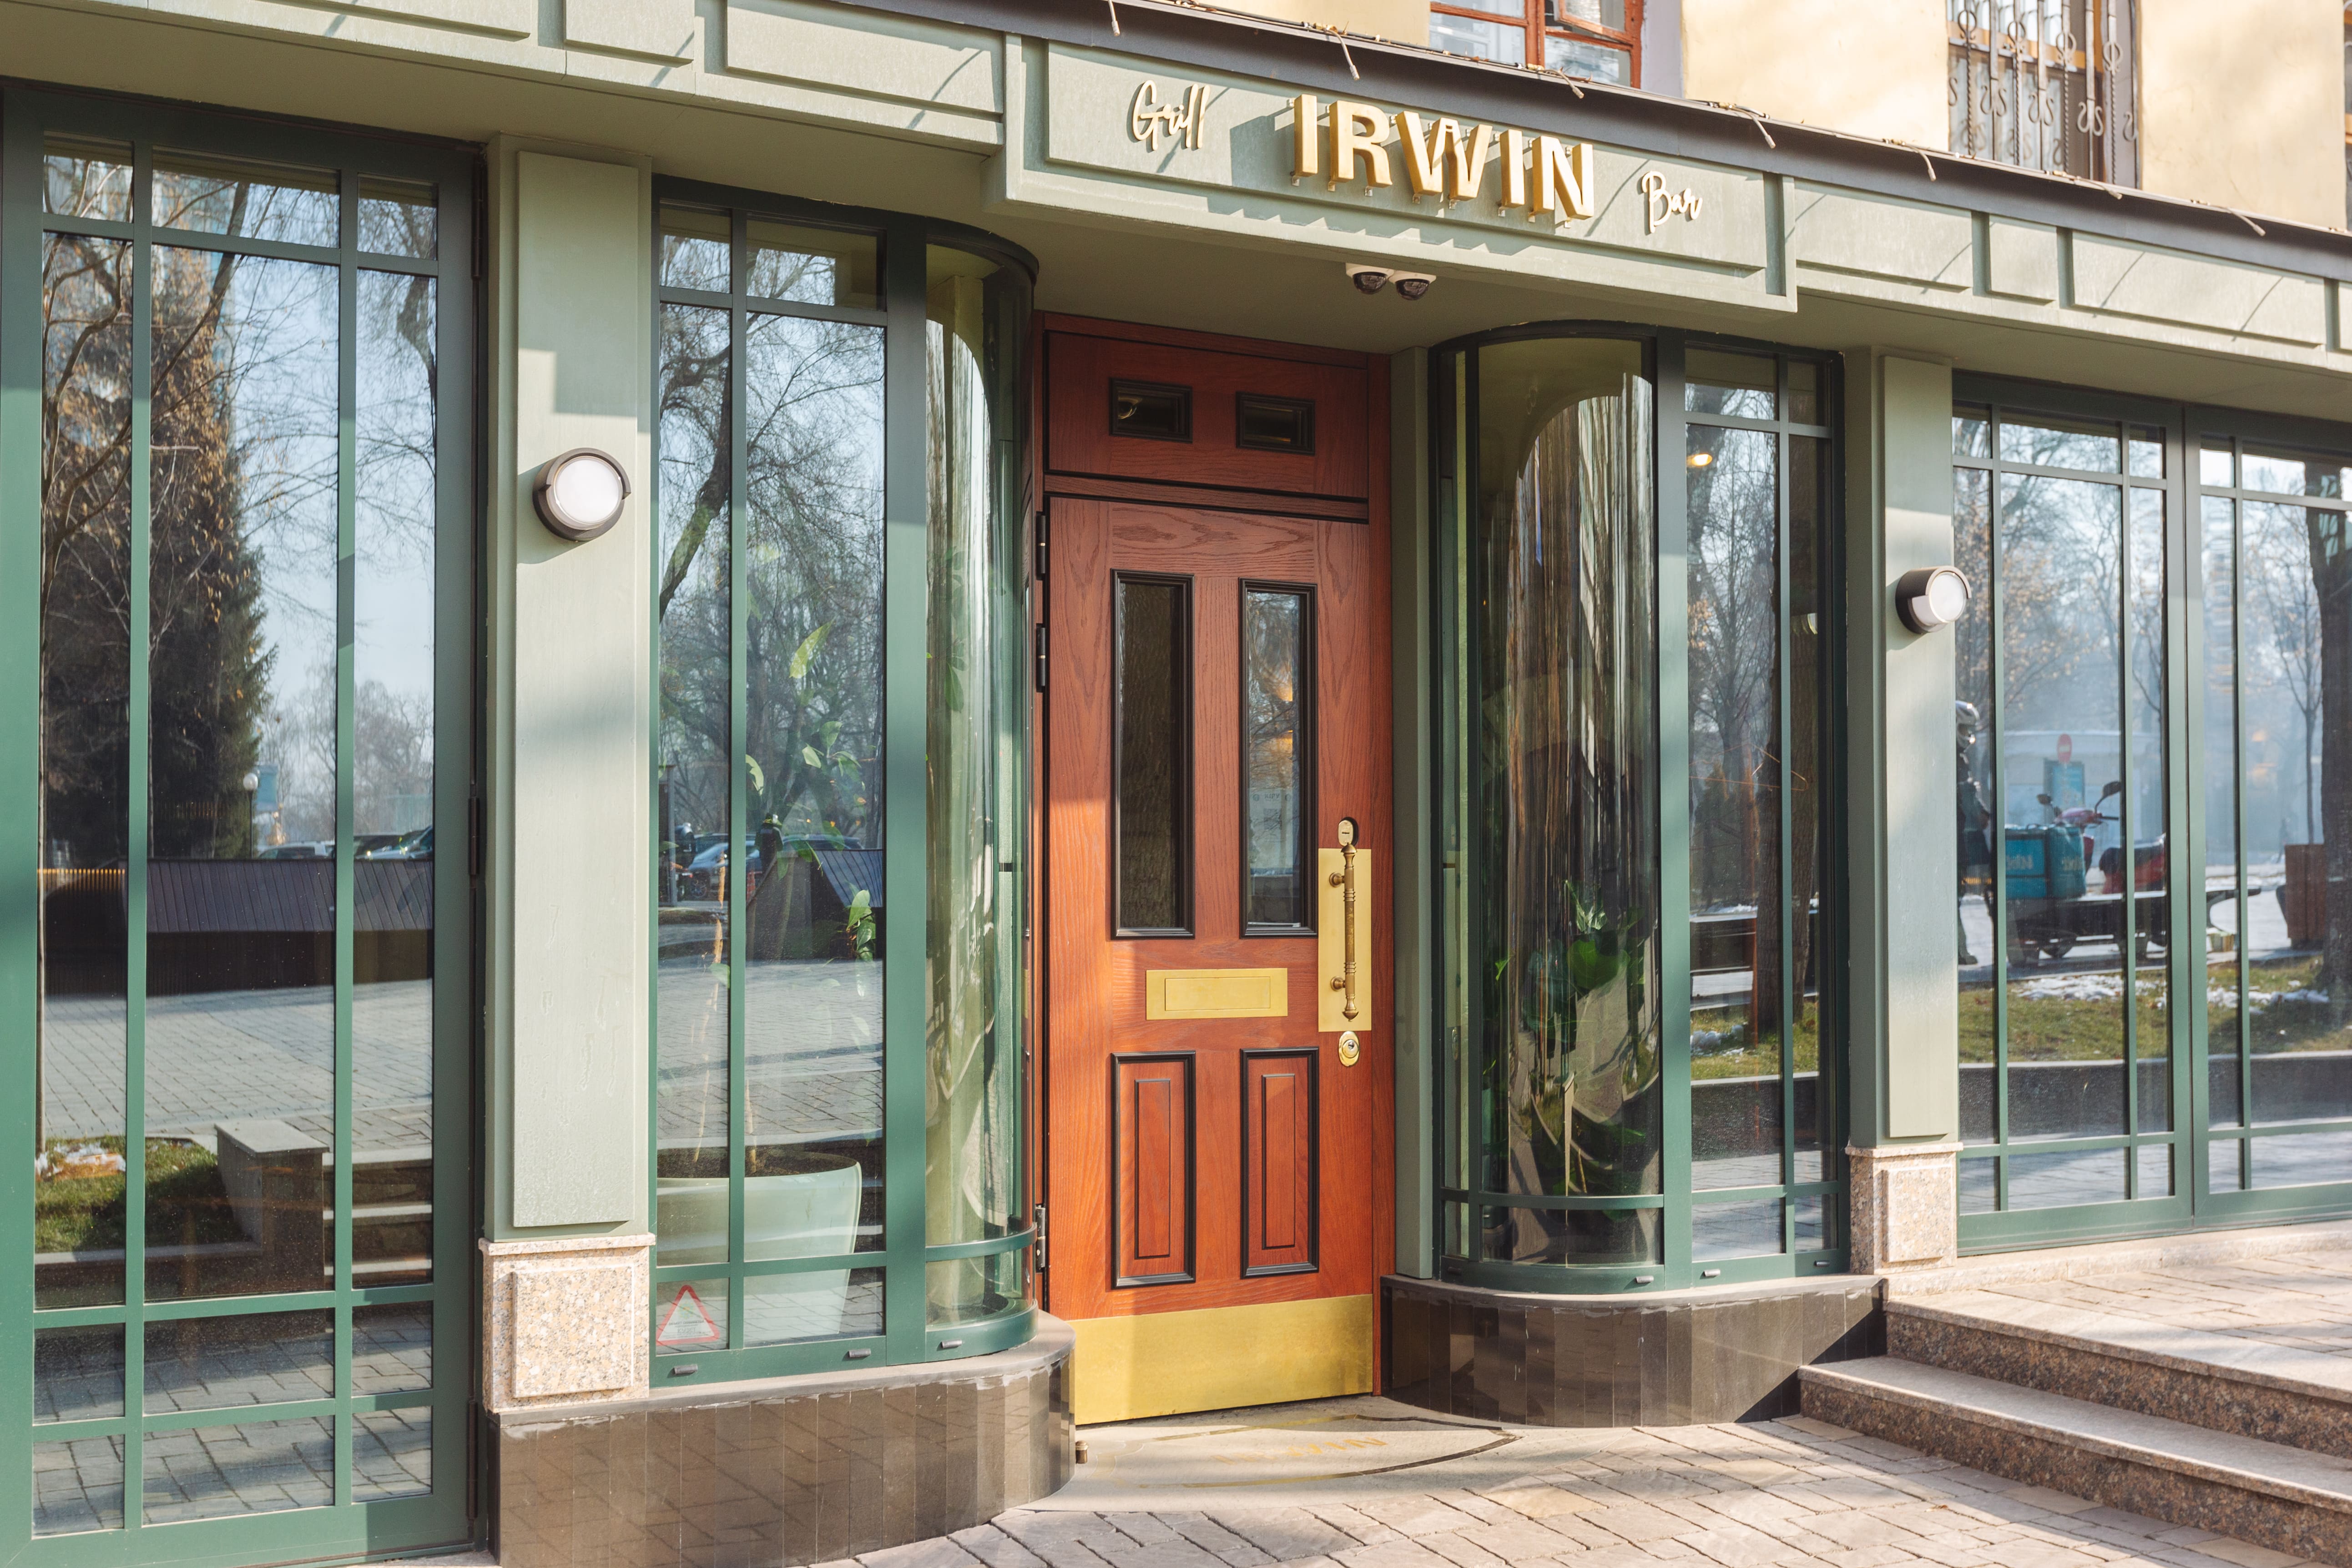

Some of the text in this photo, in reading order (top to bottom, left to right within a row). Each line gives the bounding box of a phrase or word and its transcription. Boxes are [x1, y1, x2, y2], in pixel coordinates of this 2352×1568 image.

[1132, 80, 1703, 233] Grill IRWIN Bar
